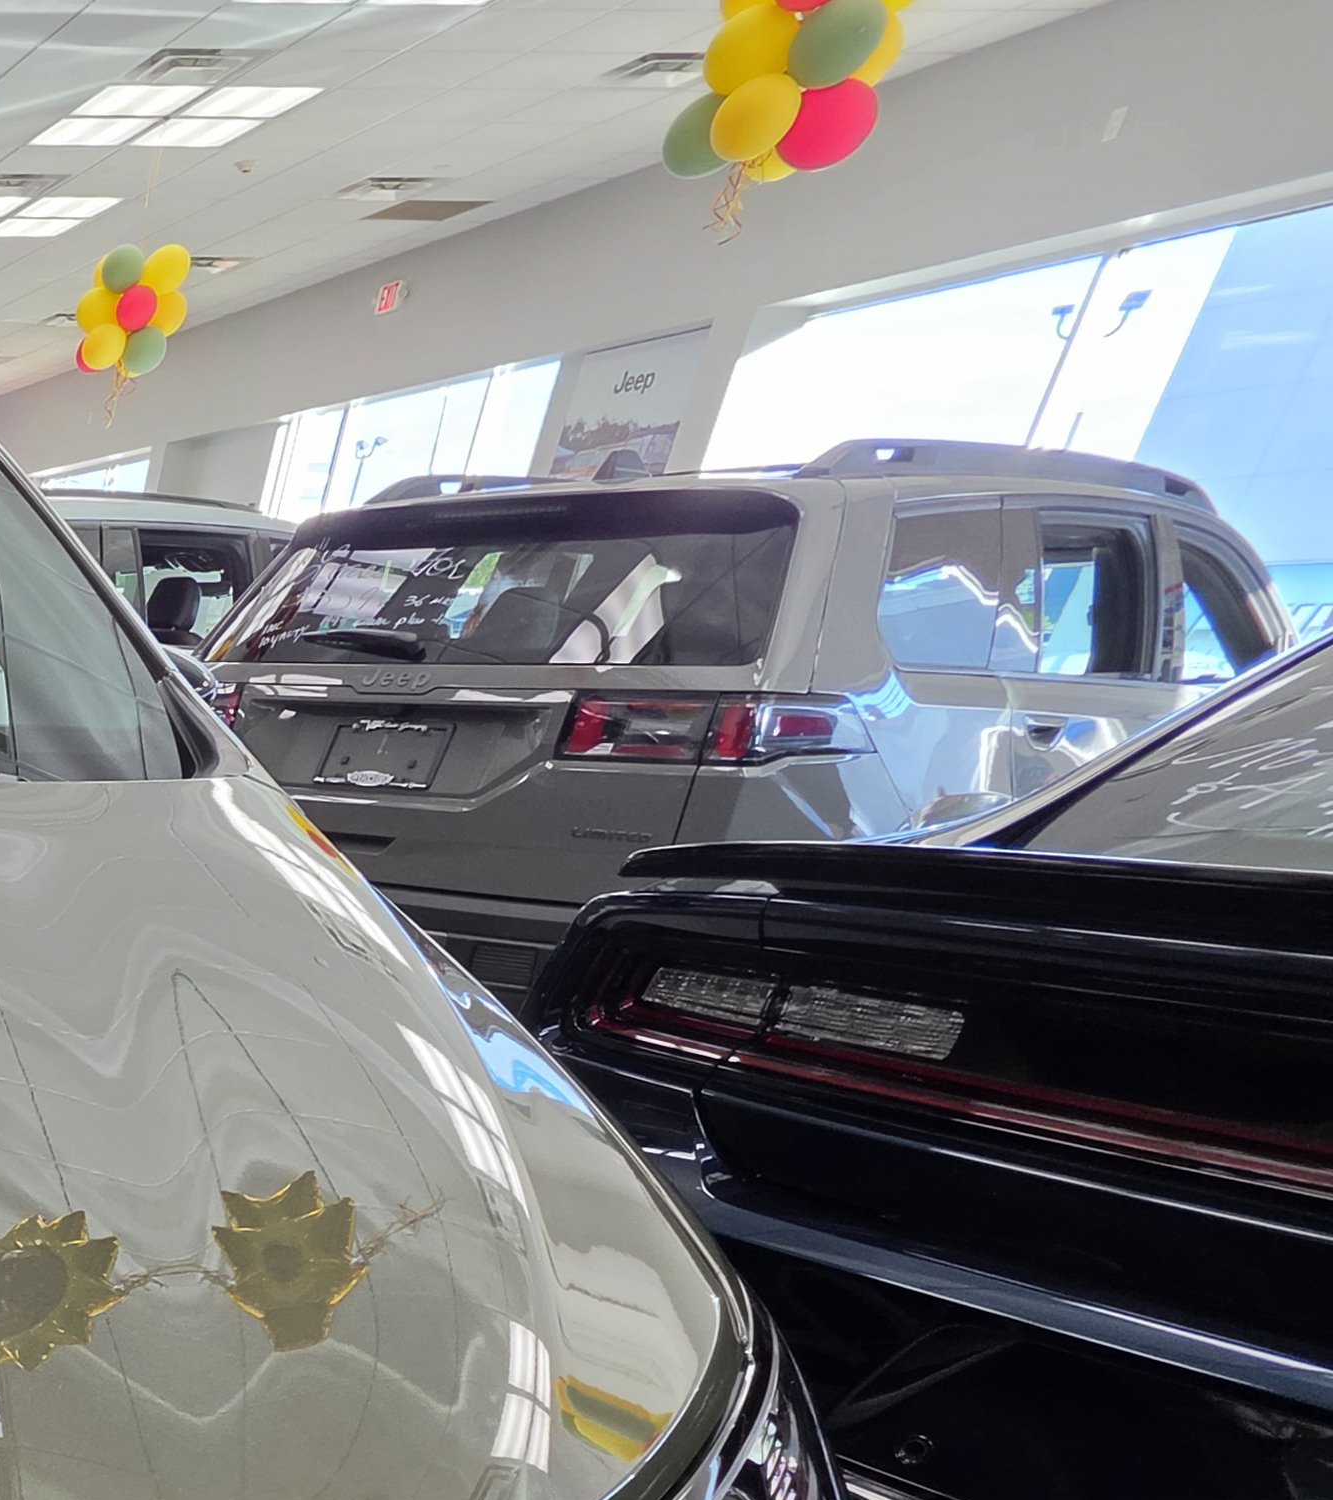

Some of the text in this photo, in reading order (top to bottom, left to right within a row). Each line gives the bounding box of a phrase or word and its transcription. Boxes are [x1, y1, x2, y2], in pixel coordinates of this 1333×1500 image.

[613, 370, 655, 394] Jeep
[361, 669, 431, 691] Jeep
[572, 826, 652, 843] LIMITED
